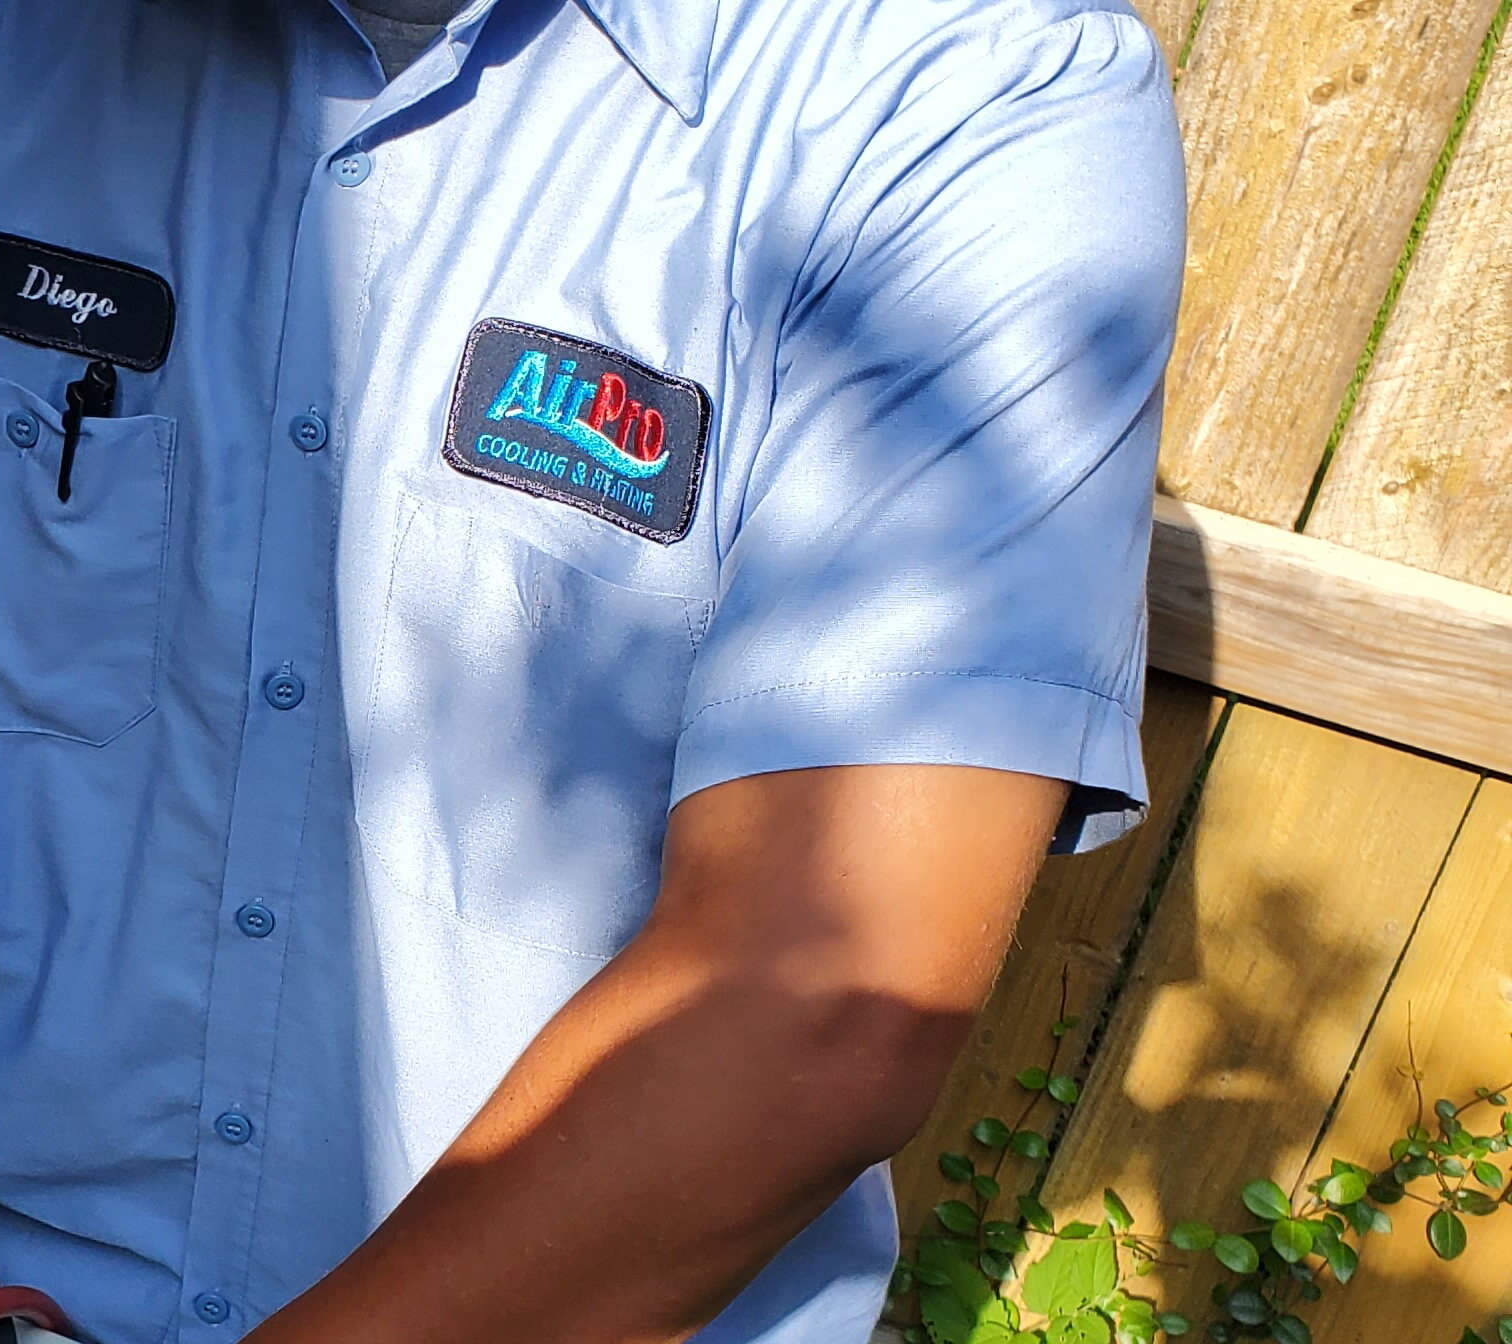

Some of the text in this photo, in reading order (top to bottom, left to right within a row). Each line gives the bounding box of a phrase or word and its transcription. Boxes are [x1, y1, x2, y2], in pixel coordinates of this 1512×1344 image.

[16, 263, 118, 324] Diego
[485, 350, 665, 464] AirPro
[474, 434, 568, 479] COOLING
[570, 460, 587, 486] &
